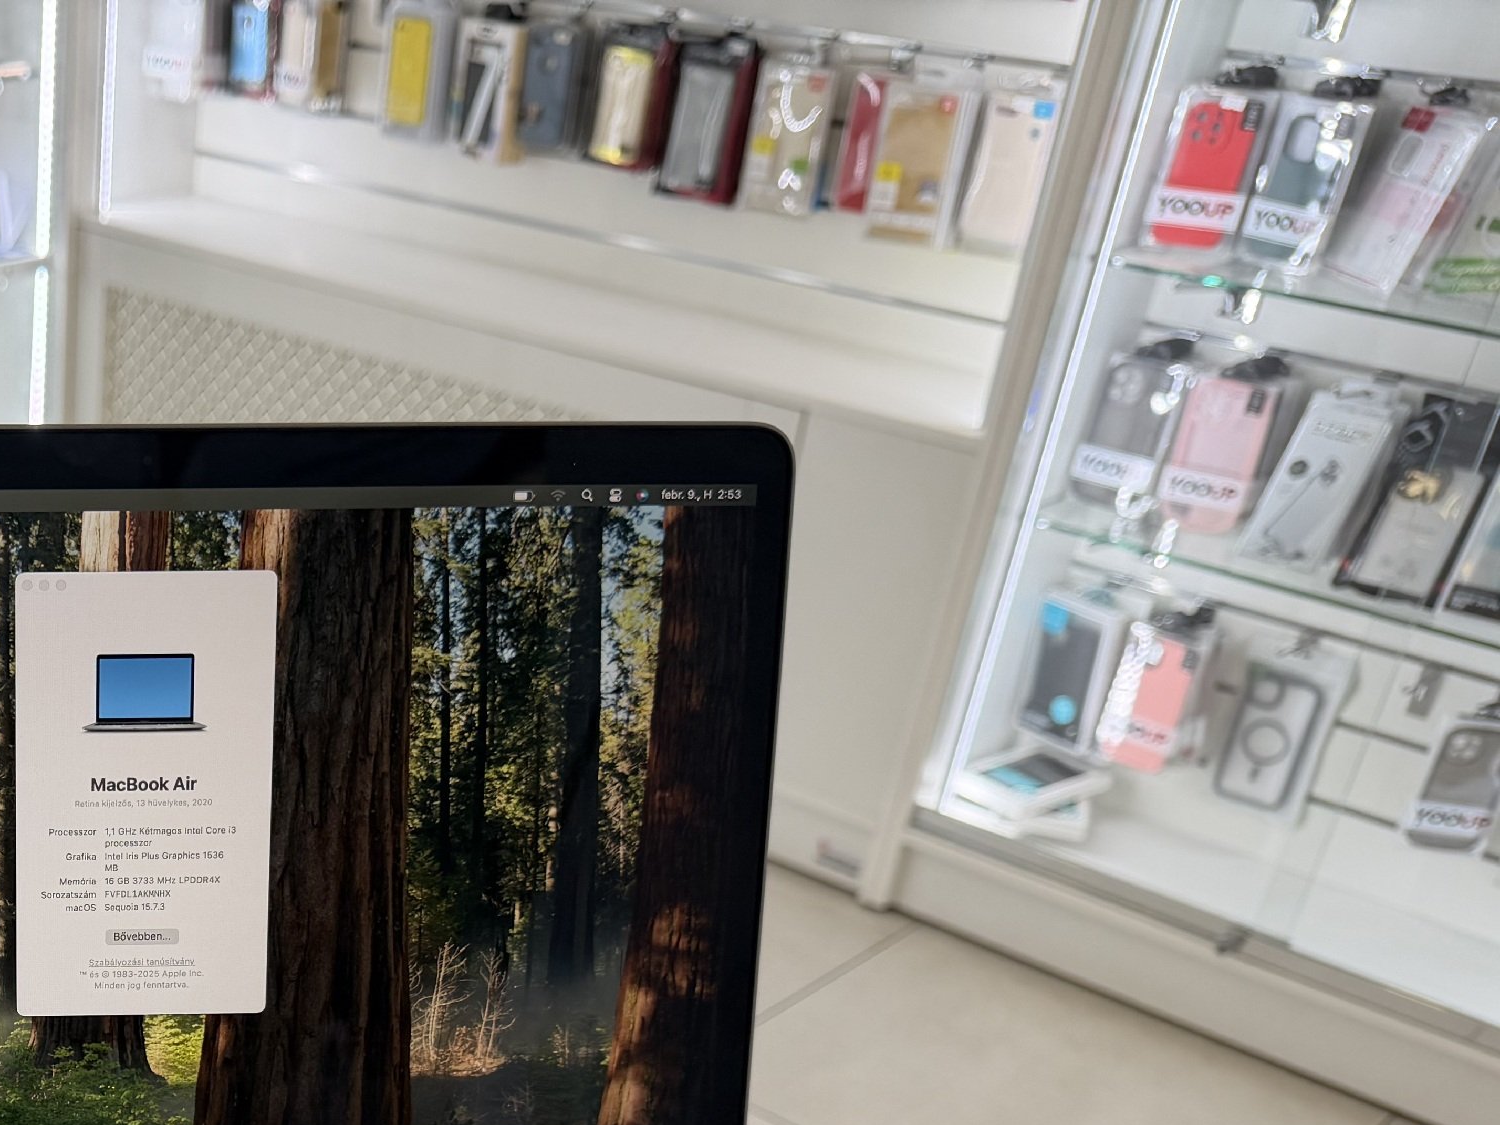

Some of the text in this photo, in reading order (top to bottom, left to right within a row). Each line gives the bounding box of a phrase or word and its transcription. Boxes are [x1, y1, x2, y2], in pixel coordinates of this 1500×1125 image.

[660, 489, 684, 500] febr.
[703, 489, 712, 500] H
[716, 489, 741, 500] 2:53
[90, 775, 197, 792] MacBook Air
[136, 799, 145, 807] 13
[191, 798, 213, 806] 2020
[48, 827, 96, 836] Processzor
[117, 827, 137, 836] GHz
[184, 826, 203, 835] Intel
[204, 826, 226, 834] Core
[227, 825, 236, 834] i3
[64, 852, 96, 861] Grafika
[104, 852, 123, 860] Intel
[125, 851, 139, 860] Iris
[141, 851, 159, 860] Plus
[161, 851, 200, 861] Graphics
[104, 864, 118, 872] MB
[59, 877, 96, 885] Memória
[104, 876, 114, 885] 16
[117, 876, 130, 885] GB
[132, 876, 154, 884] 3733
[156, 876, 175, 884] MHz
[65, 903, 96, 912] macOS
[161, 969, 186, 979] Apple
[127, 981, 140, 990] jog
